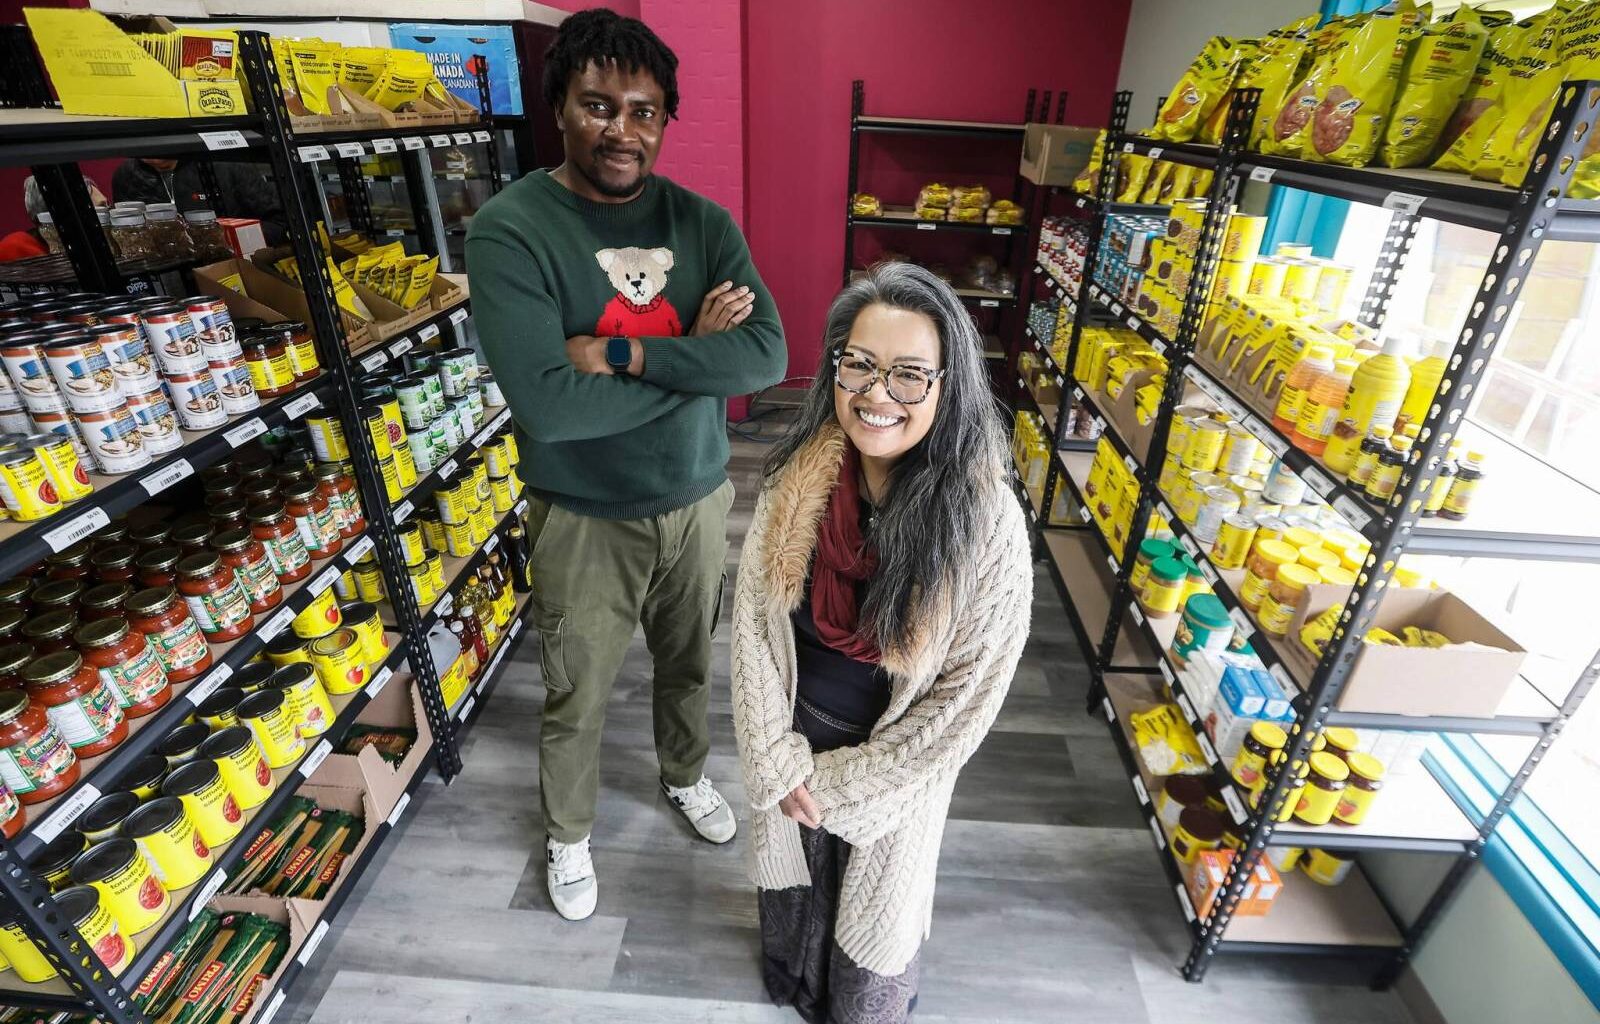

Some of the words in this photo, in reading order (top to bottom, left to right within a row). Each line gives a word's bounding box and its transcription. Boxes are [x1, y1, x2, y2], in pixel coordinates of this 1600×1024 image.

[427, 53, 450, 63] MADE
[451, 53, 461, 63] IN
[1482, 50, 1515, 68] chips
[434, 65, 464, 78] ANADA
[443, 79, 475, 88] CANADIAN
[199, 783, 223, 802] tomato
[285, 848, 312, 875] PRIMO
[110, 868, 139, 890] tomato
[188, 964, 222, 999] PRIMO
